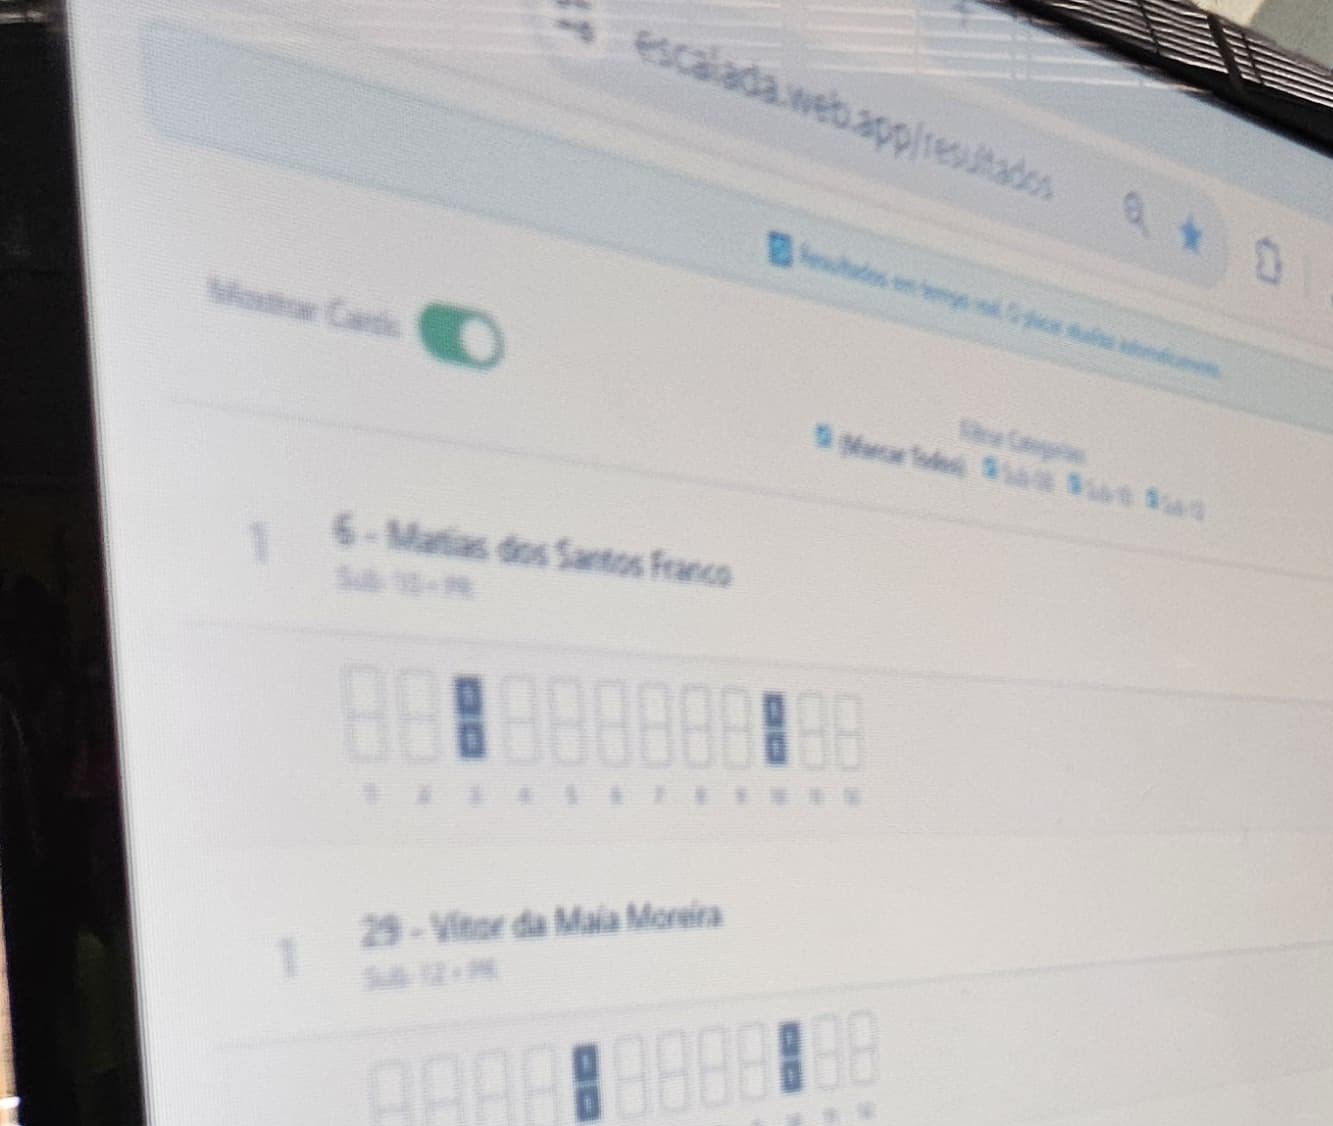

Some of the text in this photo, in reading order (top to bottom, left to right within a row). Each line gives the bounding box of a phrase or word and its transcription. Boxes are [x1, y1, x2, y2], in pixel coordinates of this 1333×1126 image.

[635, 29, 1054, 200] escalada.web.app/resultados
[332, 511, 356, 549] 6
[386, 517, 489, 561] Matias
[496, 531, 550, 568] dos
[553, 535, 646, 580] Santos
[650, 547, 734, 589] Franco
[361, 910, 402, 949] 29
[430, 905, 507, 946] Vitor
[512, 903, 549, 941] da
[554, 902, 623, 938] Maia
[626, 900, 724, 933] Moreira
